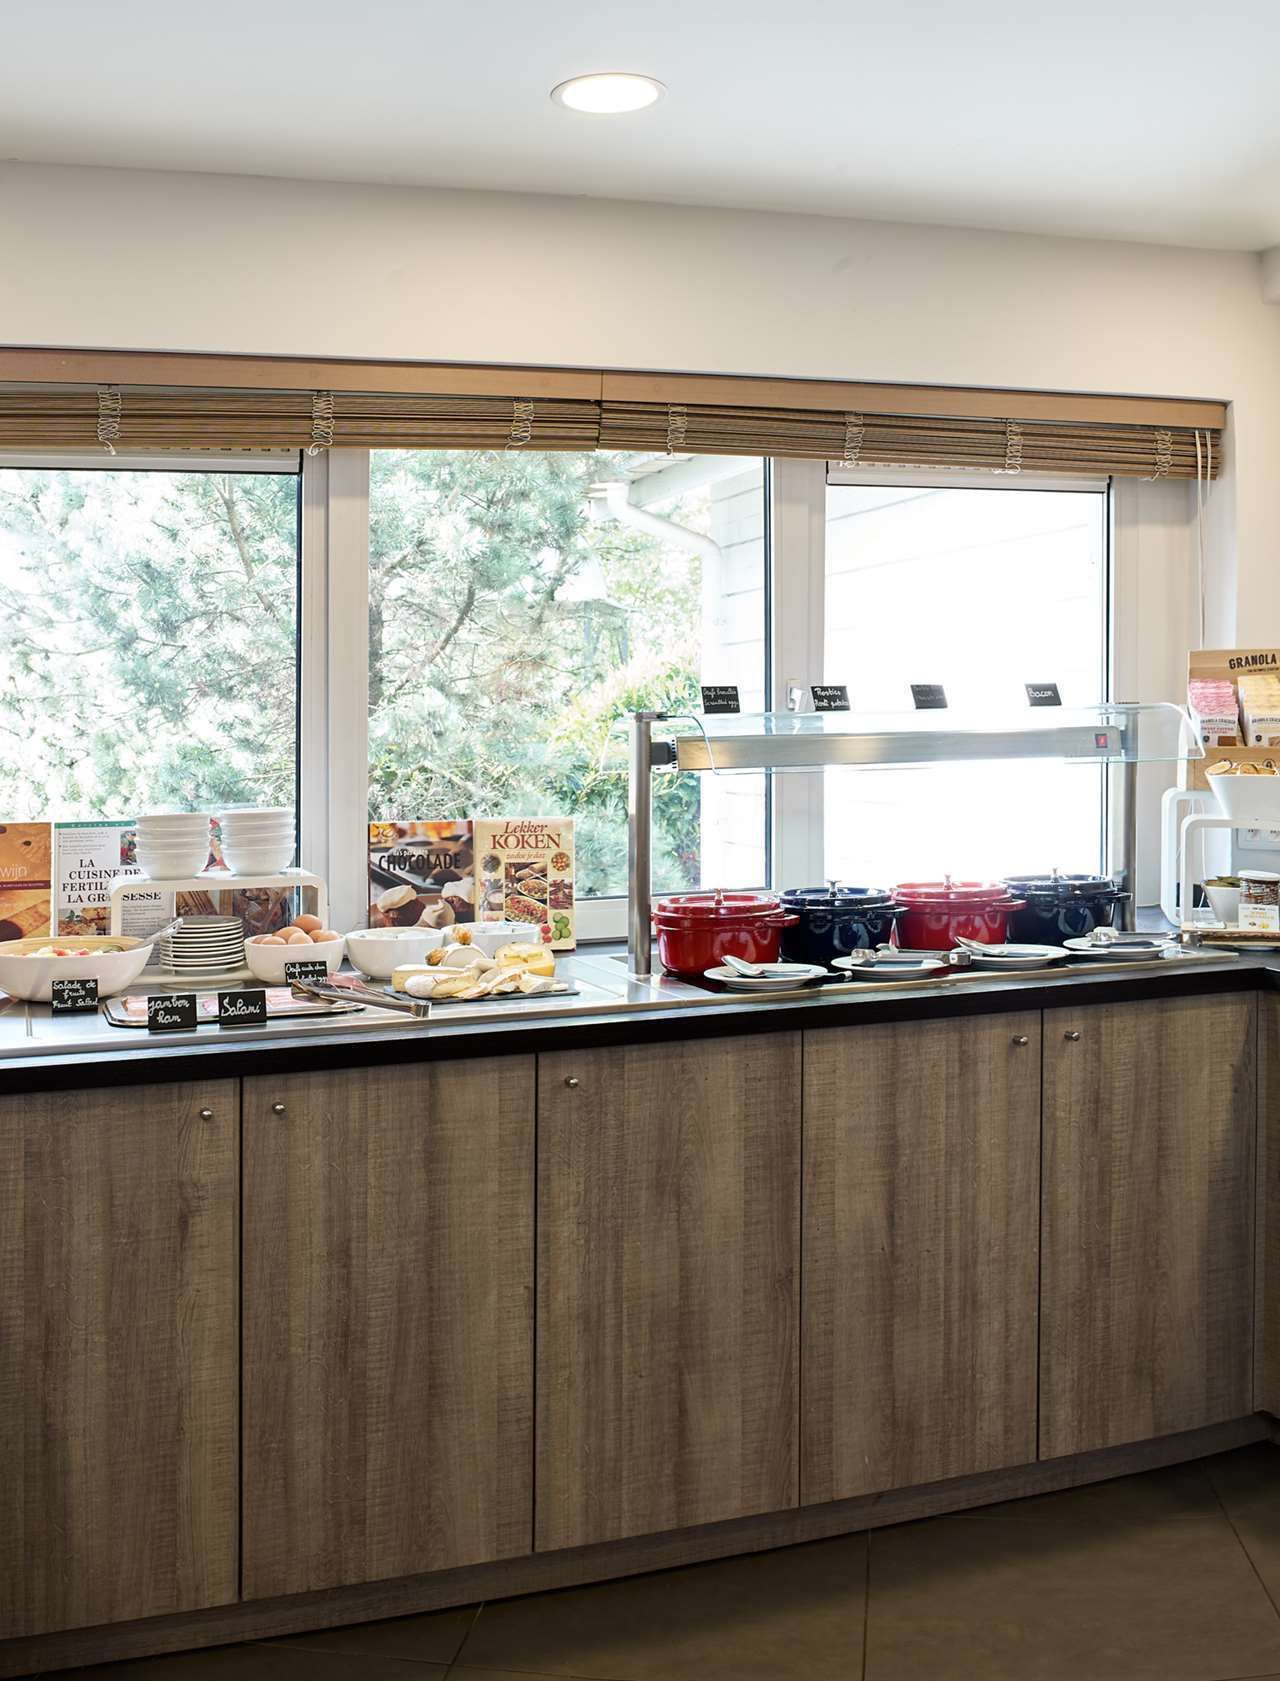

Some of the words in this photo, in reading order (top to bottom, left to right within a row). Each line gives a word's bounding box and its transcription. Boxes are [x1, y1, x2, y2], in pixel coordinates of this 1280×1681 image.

[1229, 653, 1276, 669] GRANOLA
[1028, 687, 1054, 697] Bacon
[504, 821, 548, 834] Lekker
[490, 833, 561, 849] KOKEN
[80, 859, 95, 868] LA
[379, 853, 460, 871] CHOCOLADE
[69, 869, 120, 880] CUISINE
[67, 894, 84, 903] LA
[53, 981, 81, 990] Salade
[221, 996, 261, 1016] Salami
[157, 1010, 181, 1023] ham
